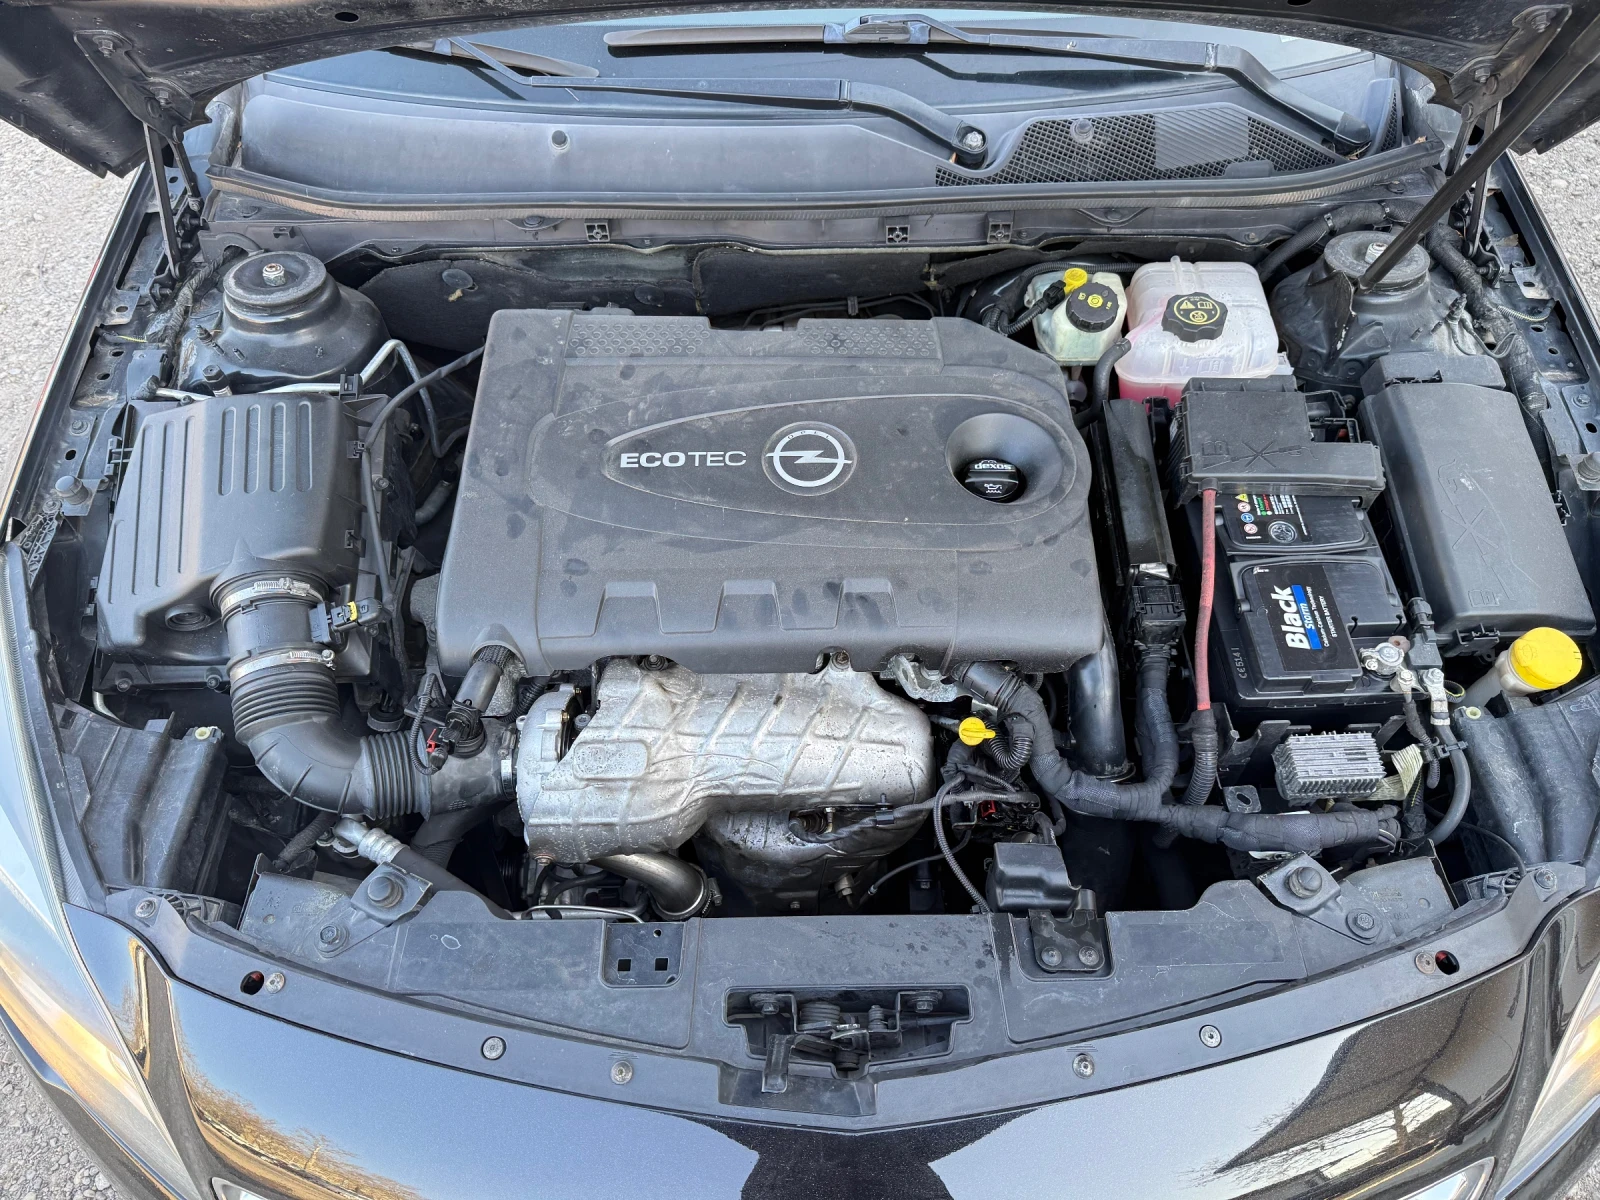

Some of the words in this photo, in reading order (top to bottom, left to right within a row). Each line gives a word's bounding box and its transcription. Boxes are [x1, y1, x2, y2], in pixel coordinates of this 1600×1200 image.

[974, 460, 1013, 470] dexos
[1305, 586, 1318, 610] Technology
[1318, 595, 1330, 616] BATTERY
[1270, 585, 1311, 650] Black
[1300, 603, 1315, 630] Storm
[1324, 616, 1338, 638] STARTER
